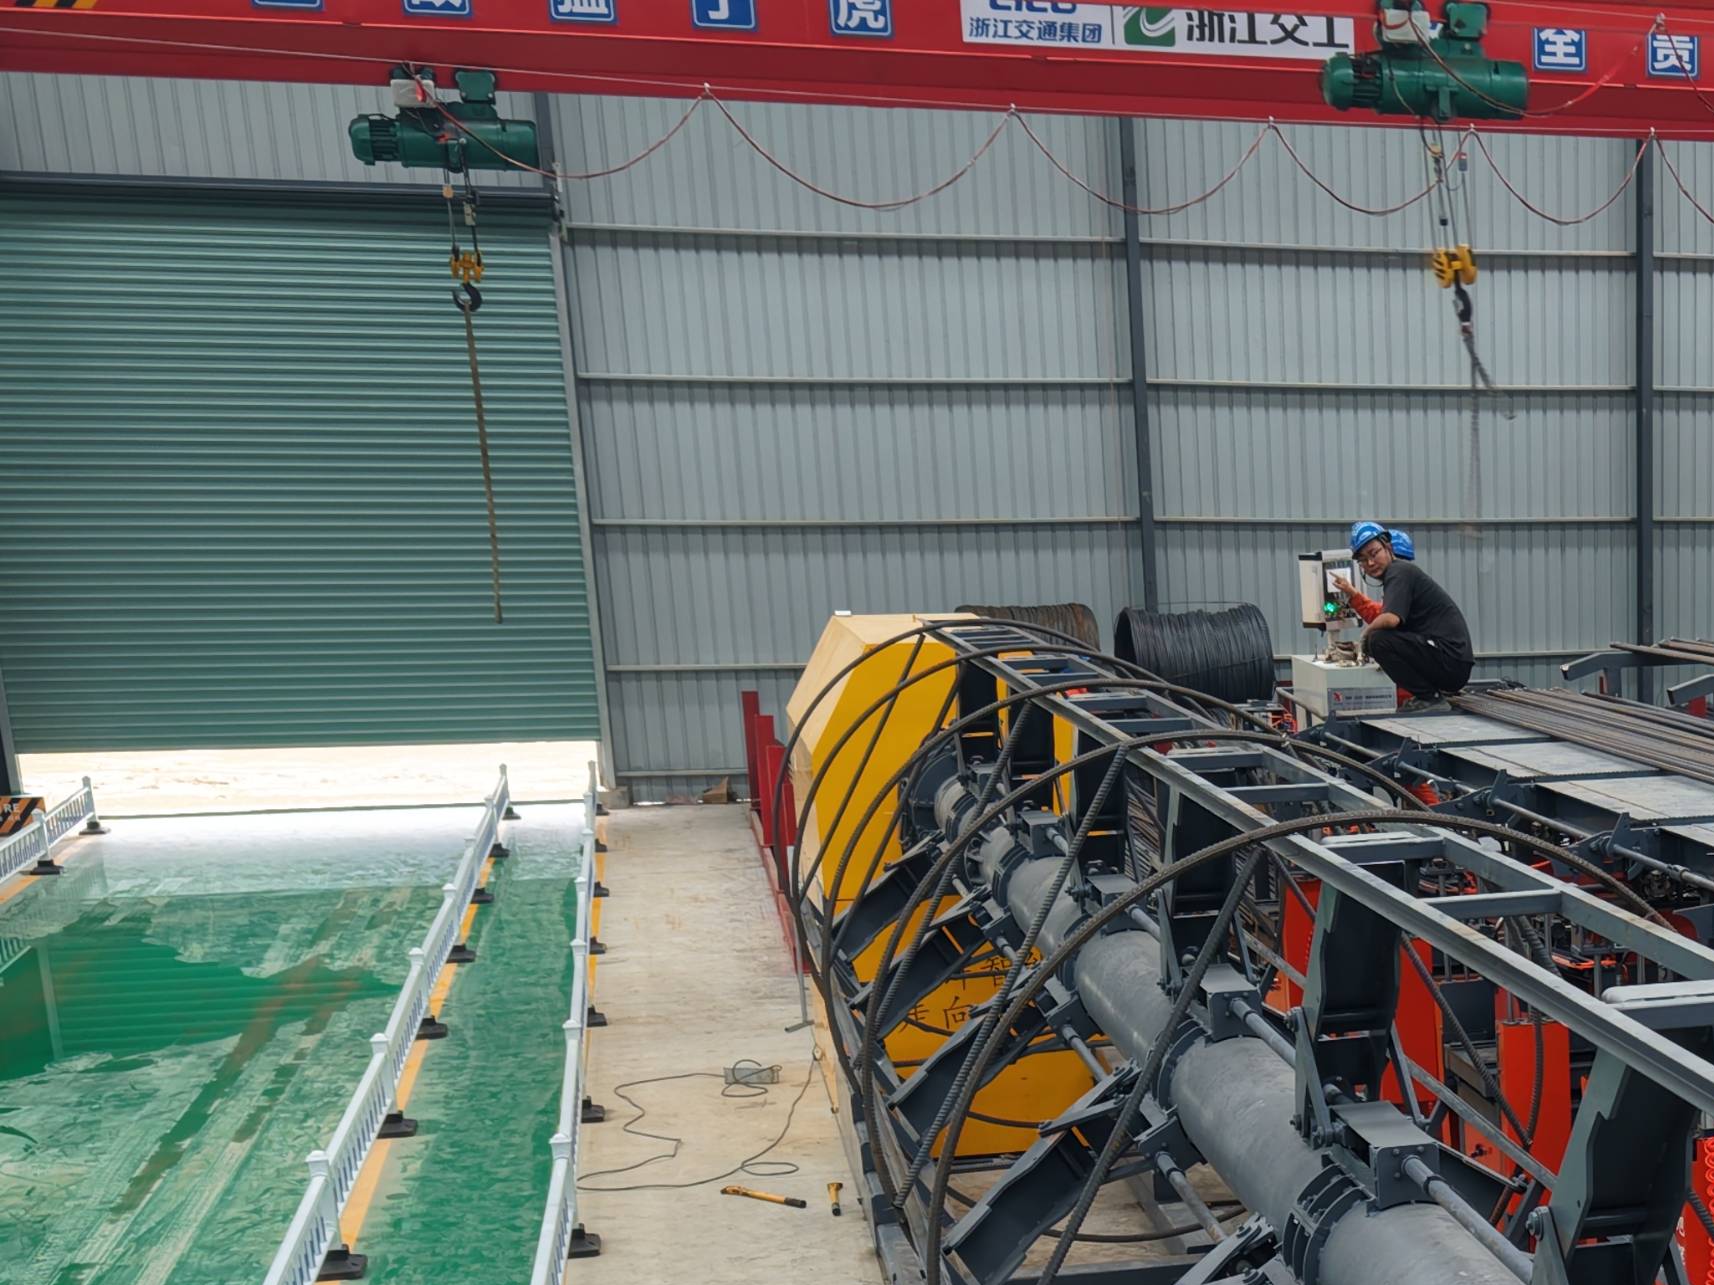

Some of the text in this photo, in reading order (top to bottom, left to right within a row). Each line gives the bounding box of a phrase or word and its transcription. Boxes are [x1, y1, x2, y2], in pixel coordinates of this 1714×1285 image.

[968, 16, 1103, 43] 浙江交通集团
